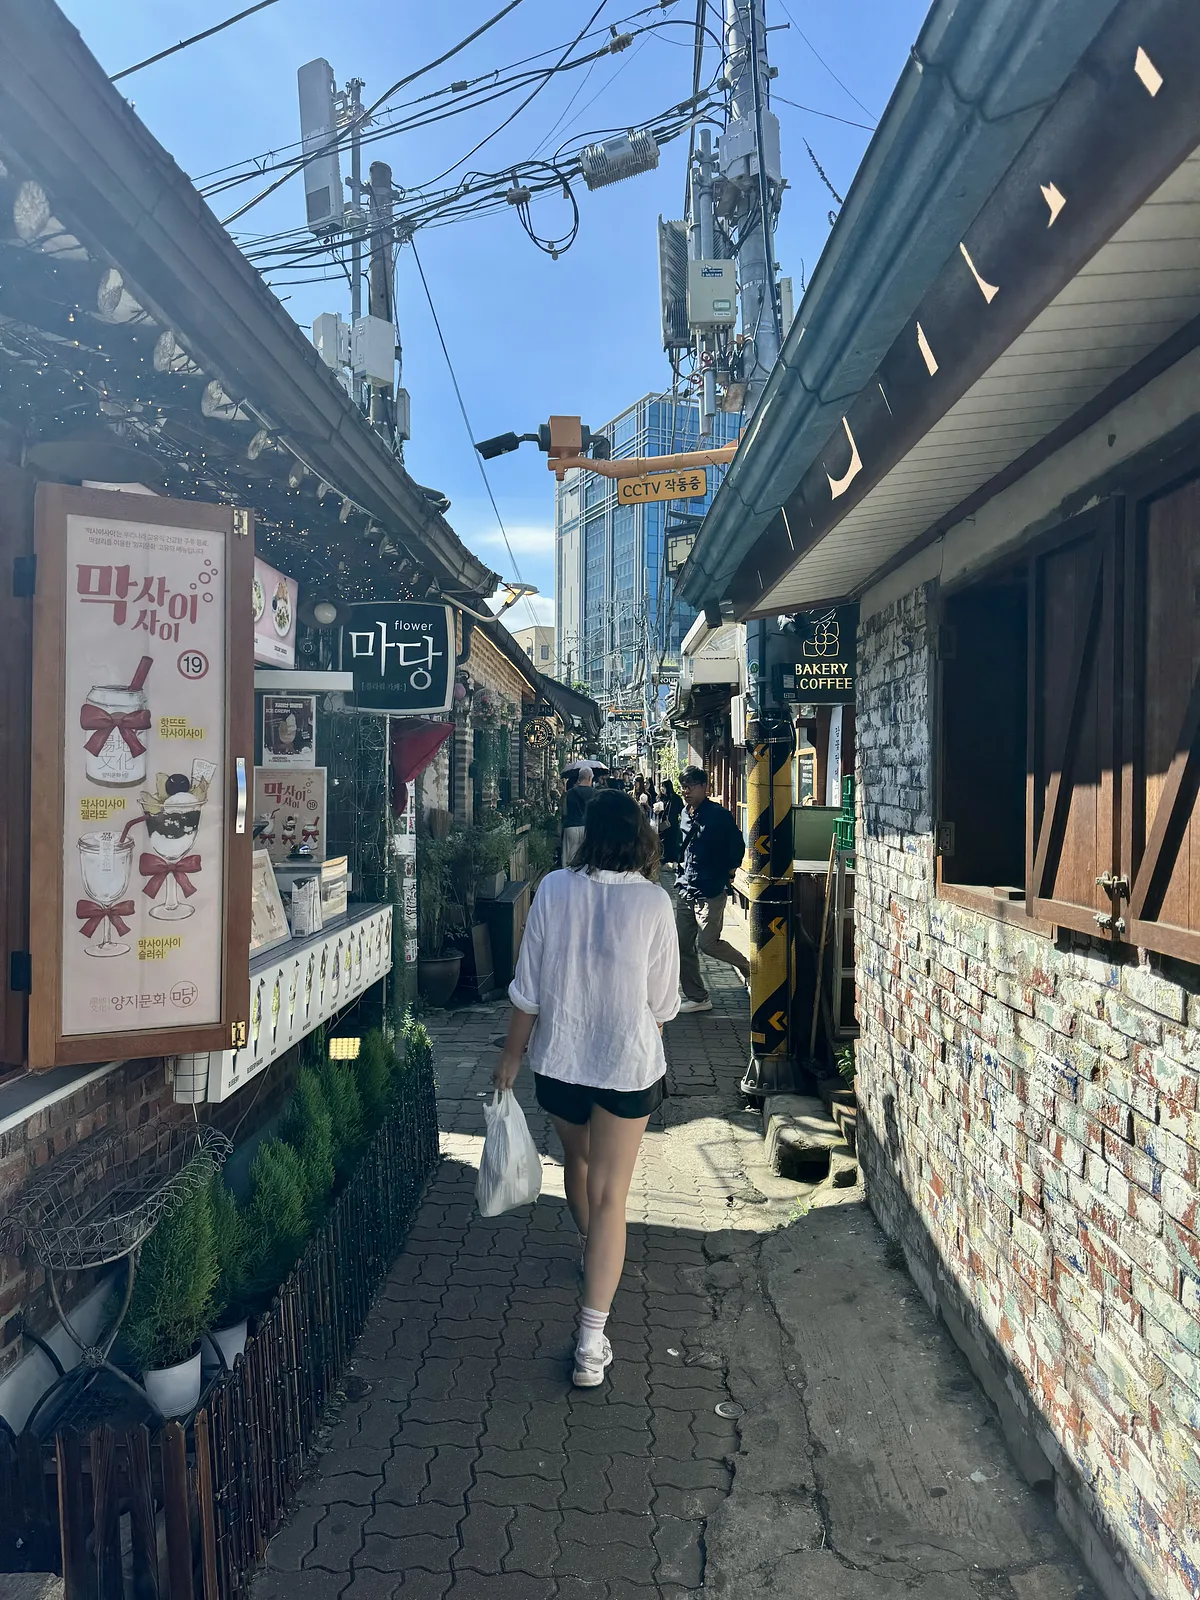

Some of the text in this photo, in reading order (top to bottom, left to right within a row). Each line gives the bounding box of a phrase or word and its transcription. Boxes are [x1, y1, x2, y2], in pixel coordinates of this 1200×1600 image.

[622, 476, 702, 498] CCTV 작동중
[131, 609, 180, 643] 사이
[394, 620, 433, 632] flower
[348, 621, 443, 690] 마당
[183, 656, 203, 673] 19
[795, 663, 849, 675] BAKERY
[800, 677, 853, 690] COFFEE
[160, 728, 203, 739] 막사이사이
[98, 753, 135, 771] 文化
[80, 798, 126, 810] 막사이사이
[308, 801, 317, 809] 19
[80, 809, 108, 821] 젤라또
[138, 937, 181, 950] 막사이사이
[138, 948, 165, 961] 슬러쉬
[111, 992, 167, 1011] 양지문화
